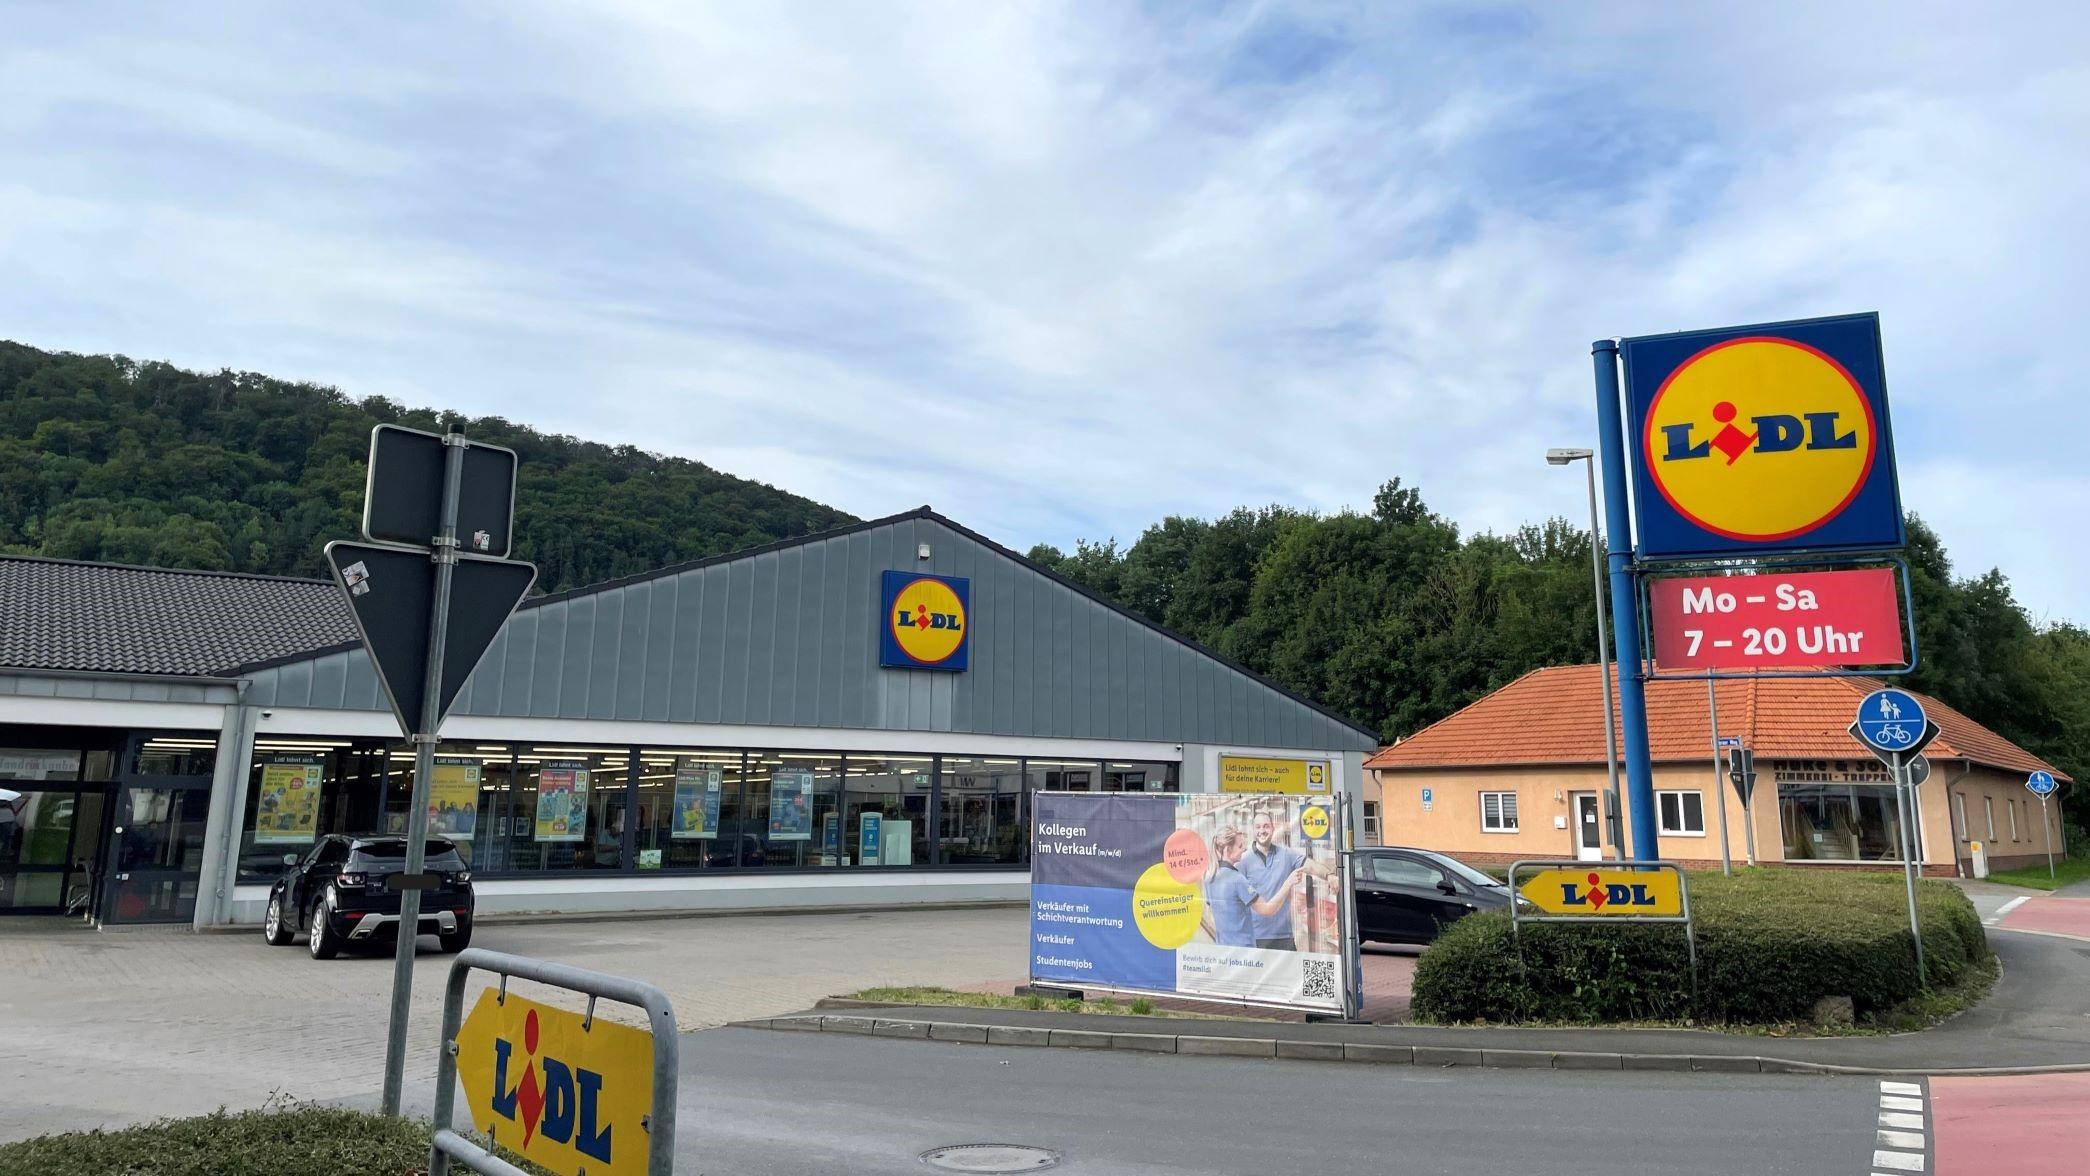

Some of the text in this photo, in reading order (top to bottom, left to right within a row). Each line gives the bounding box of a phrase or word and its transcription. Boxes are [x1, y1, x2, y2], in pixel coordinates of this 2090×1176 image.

[1682, 586, 1737, 614] Mo
[1775, 583, 1819, 612] Sa
[1684, 630, 1704, 657] 7
[1742, 627, 1787, 656] 20
[1796, 625, 1864, 654] Uhr
[1225, 764, 1237, 772] Lidl
[1238, 764, 1255, 773] lohnt
[1256, 765, 1269, 773] sich
[1274, 766, 1290, 774] auch
[1225, 773, 1281, 784] für deine Karriere!
[1775, 772, 1833, 781] ZIMMEREI
[1038, 823, 1087, 839] Kollegen
[1038, 841, 1122, 858] im Verkauf (m/w/d)
[1168, 848, 1188, 858] Mind.
[1169, 861, 1177, 869] 14
[1036, 900, 1090, 913] Verkäufer mit
[1139, 893, 1194, 909] Quereinsteiger
[1142, 905, 1189, 919] willkommen!
[1036, 911, 1124, 928] Schichtverantwortung
[1036, 933, 1075, 945] Verkäufer
[1036, 955, 1094, 971] Studentenjobs
[1182, 954, 1203, 963] Bewirb
[1204, 956, 1217, 964] dich
[1229, 957, 1264, 968] jobs.lidl.de
